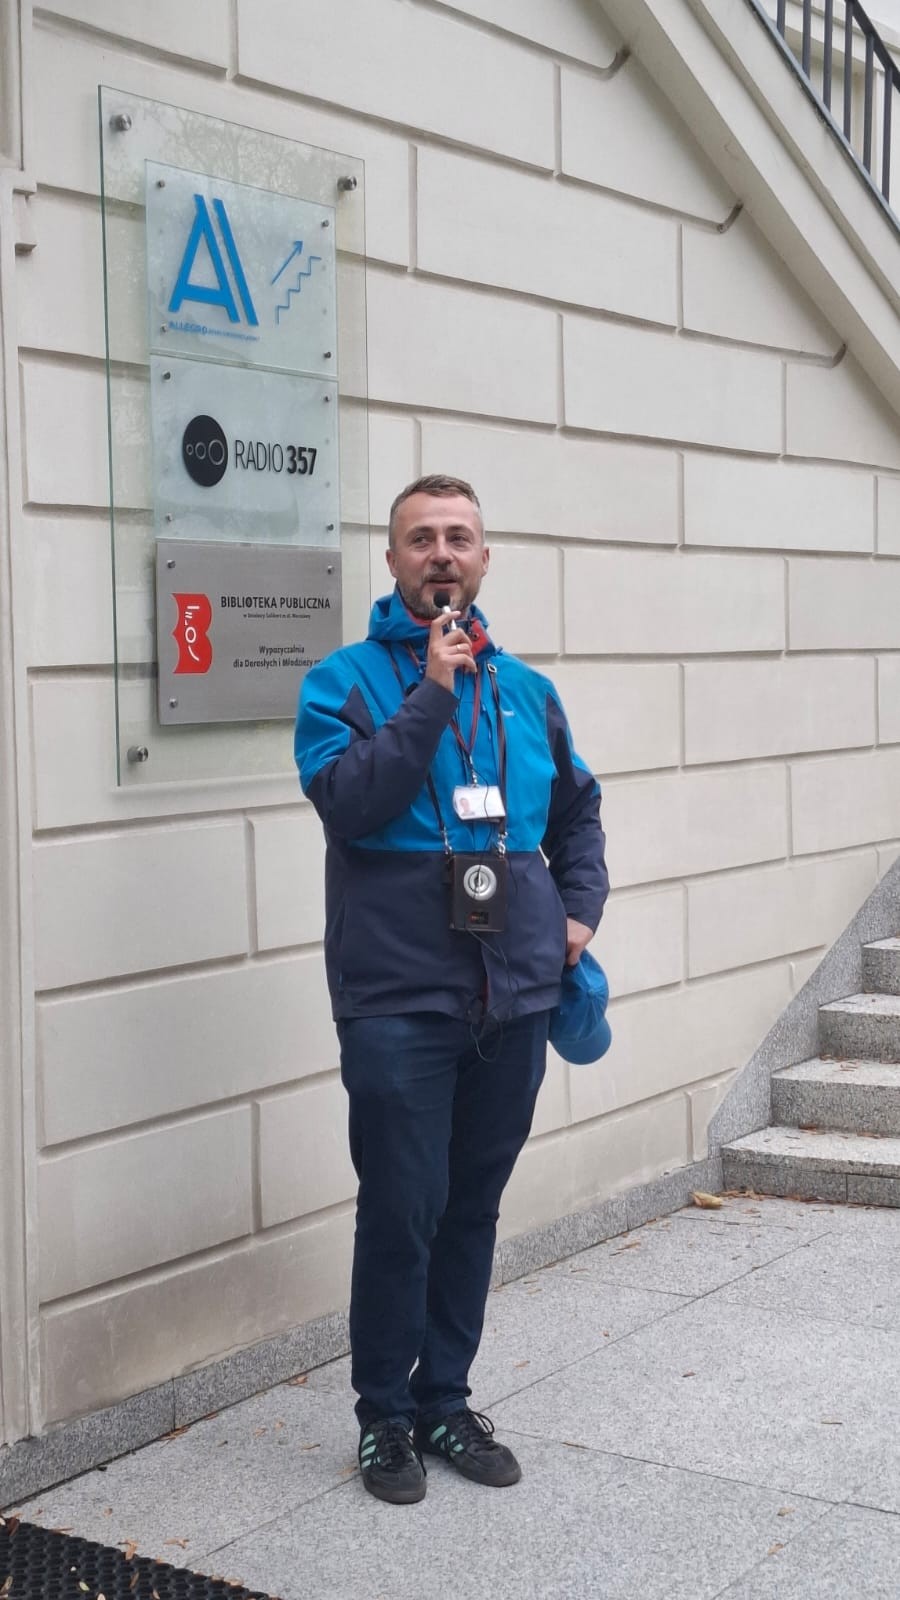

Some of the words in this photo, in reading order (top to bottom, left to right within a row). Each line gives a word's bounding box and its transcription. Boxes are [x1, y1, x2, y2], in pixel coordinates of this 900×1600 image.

[235, 439, 284, 473] RADIO
[286, 445, 317, 475] 357
[221, 596, 277, 609] BIBLIOTEKA
[280, 597, 331, 609] PUBLICZNA
[233, 659, 243, 668] dla
